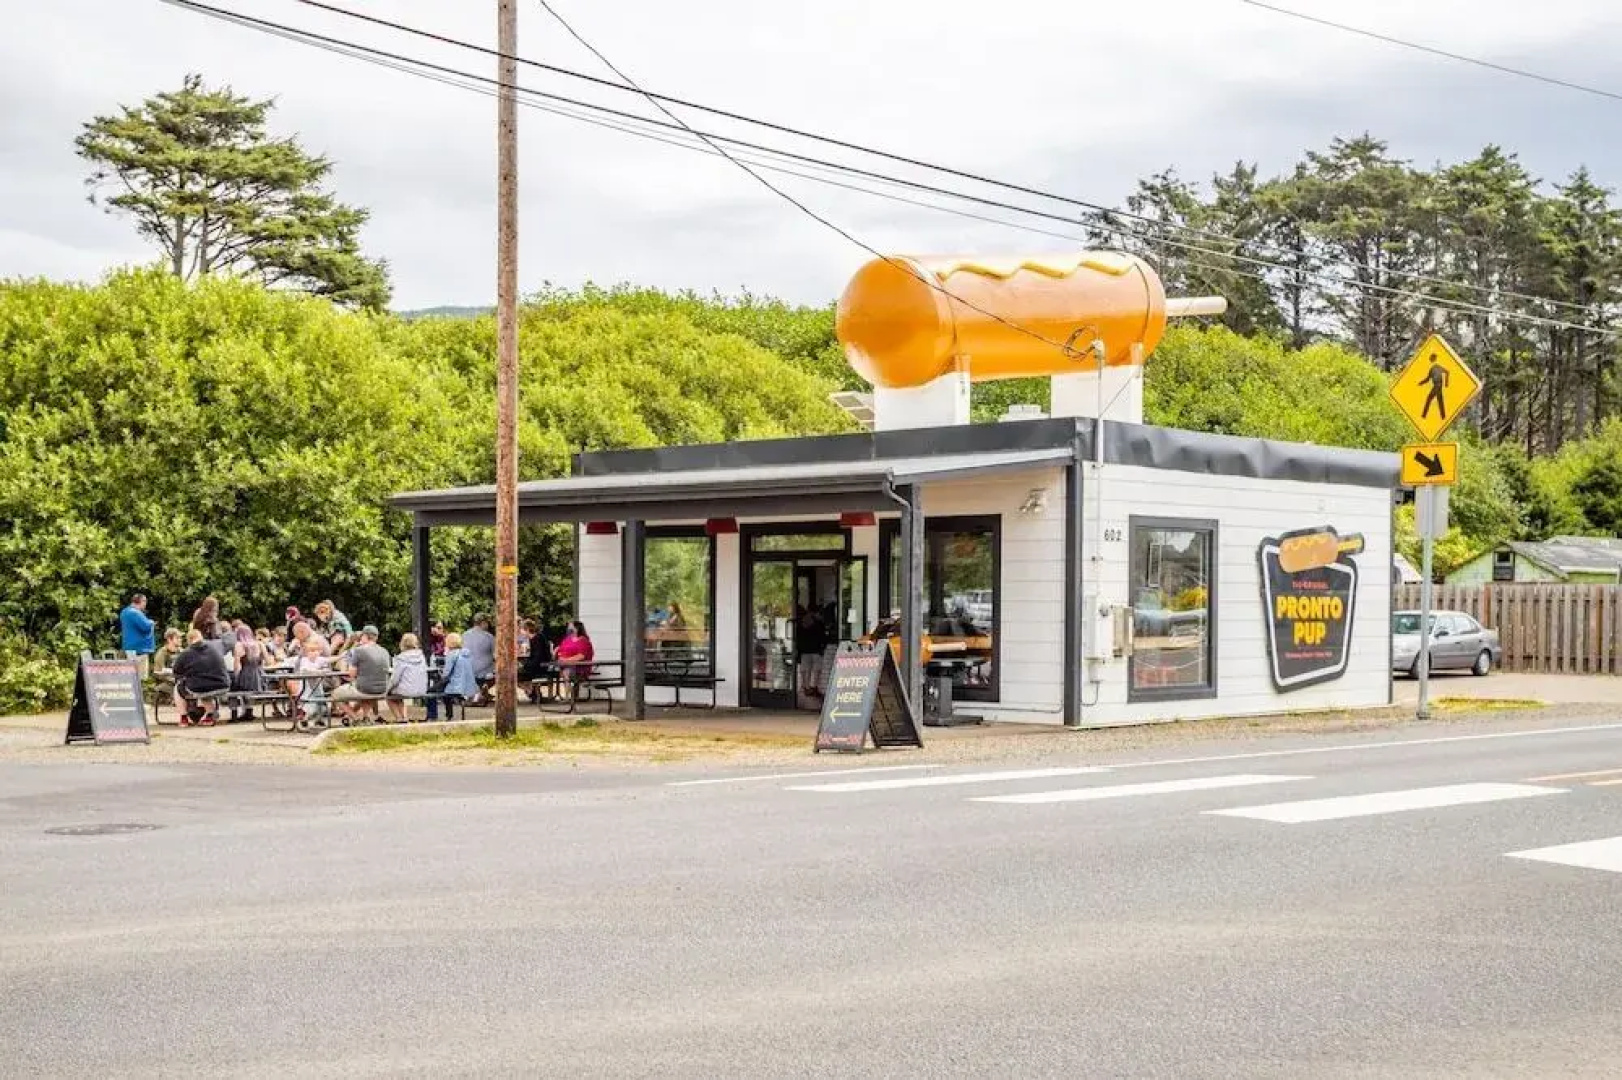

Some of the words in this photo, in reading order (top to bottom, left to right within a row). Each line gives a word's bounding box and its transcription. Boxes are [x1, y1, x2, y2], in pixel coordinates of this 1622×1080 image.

[1276, 596, 1343, 619] PRONTO
[1294, 622, 1326, 645] PUP
[836, 676, 870, 687] ENTER
[836, 692, 864, 703] HERE
